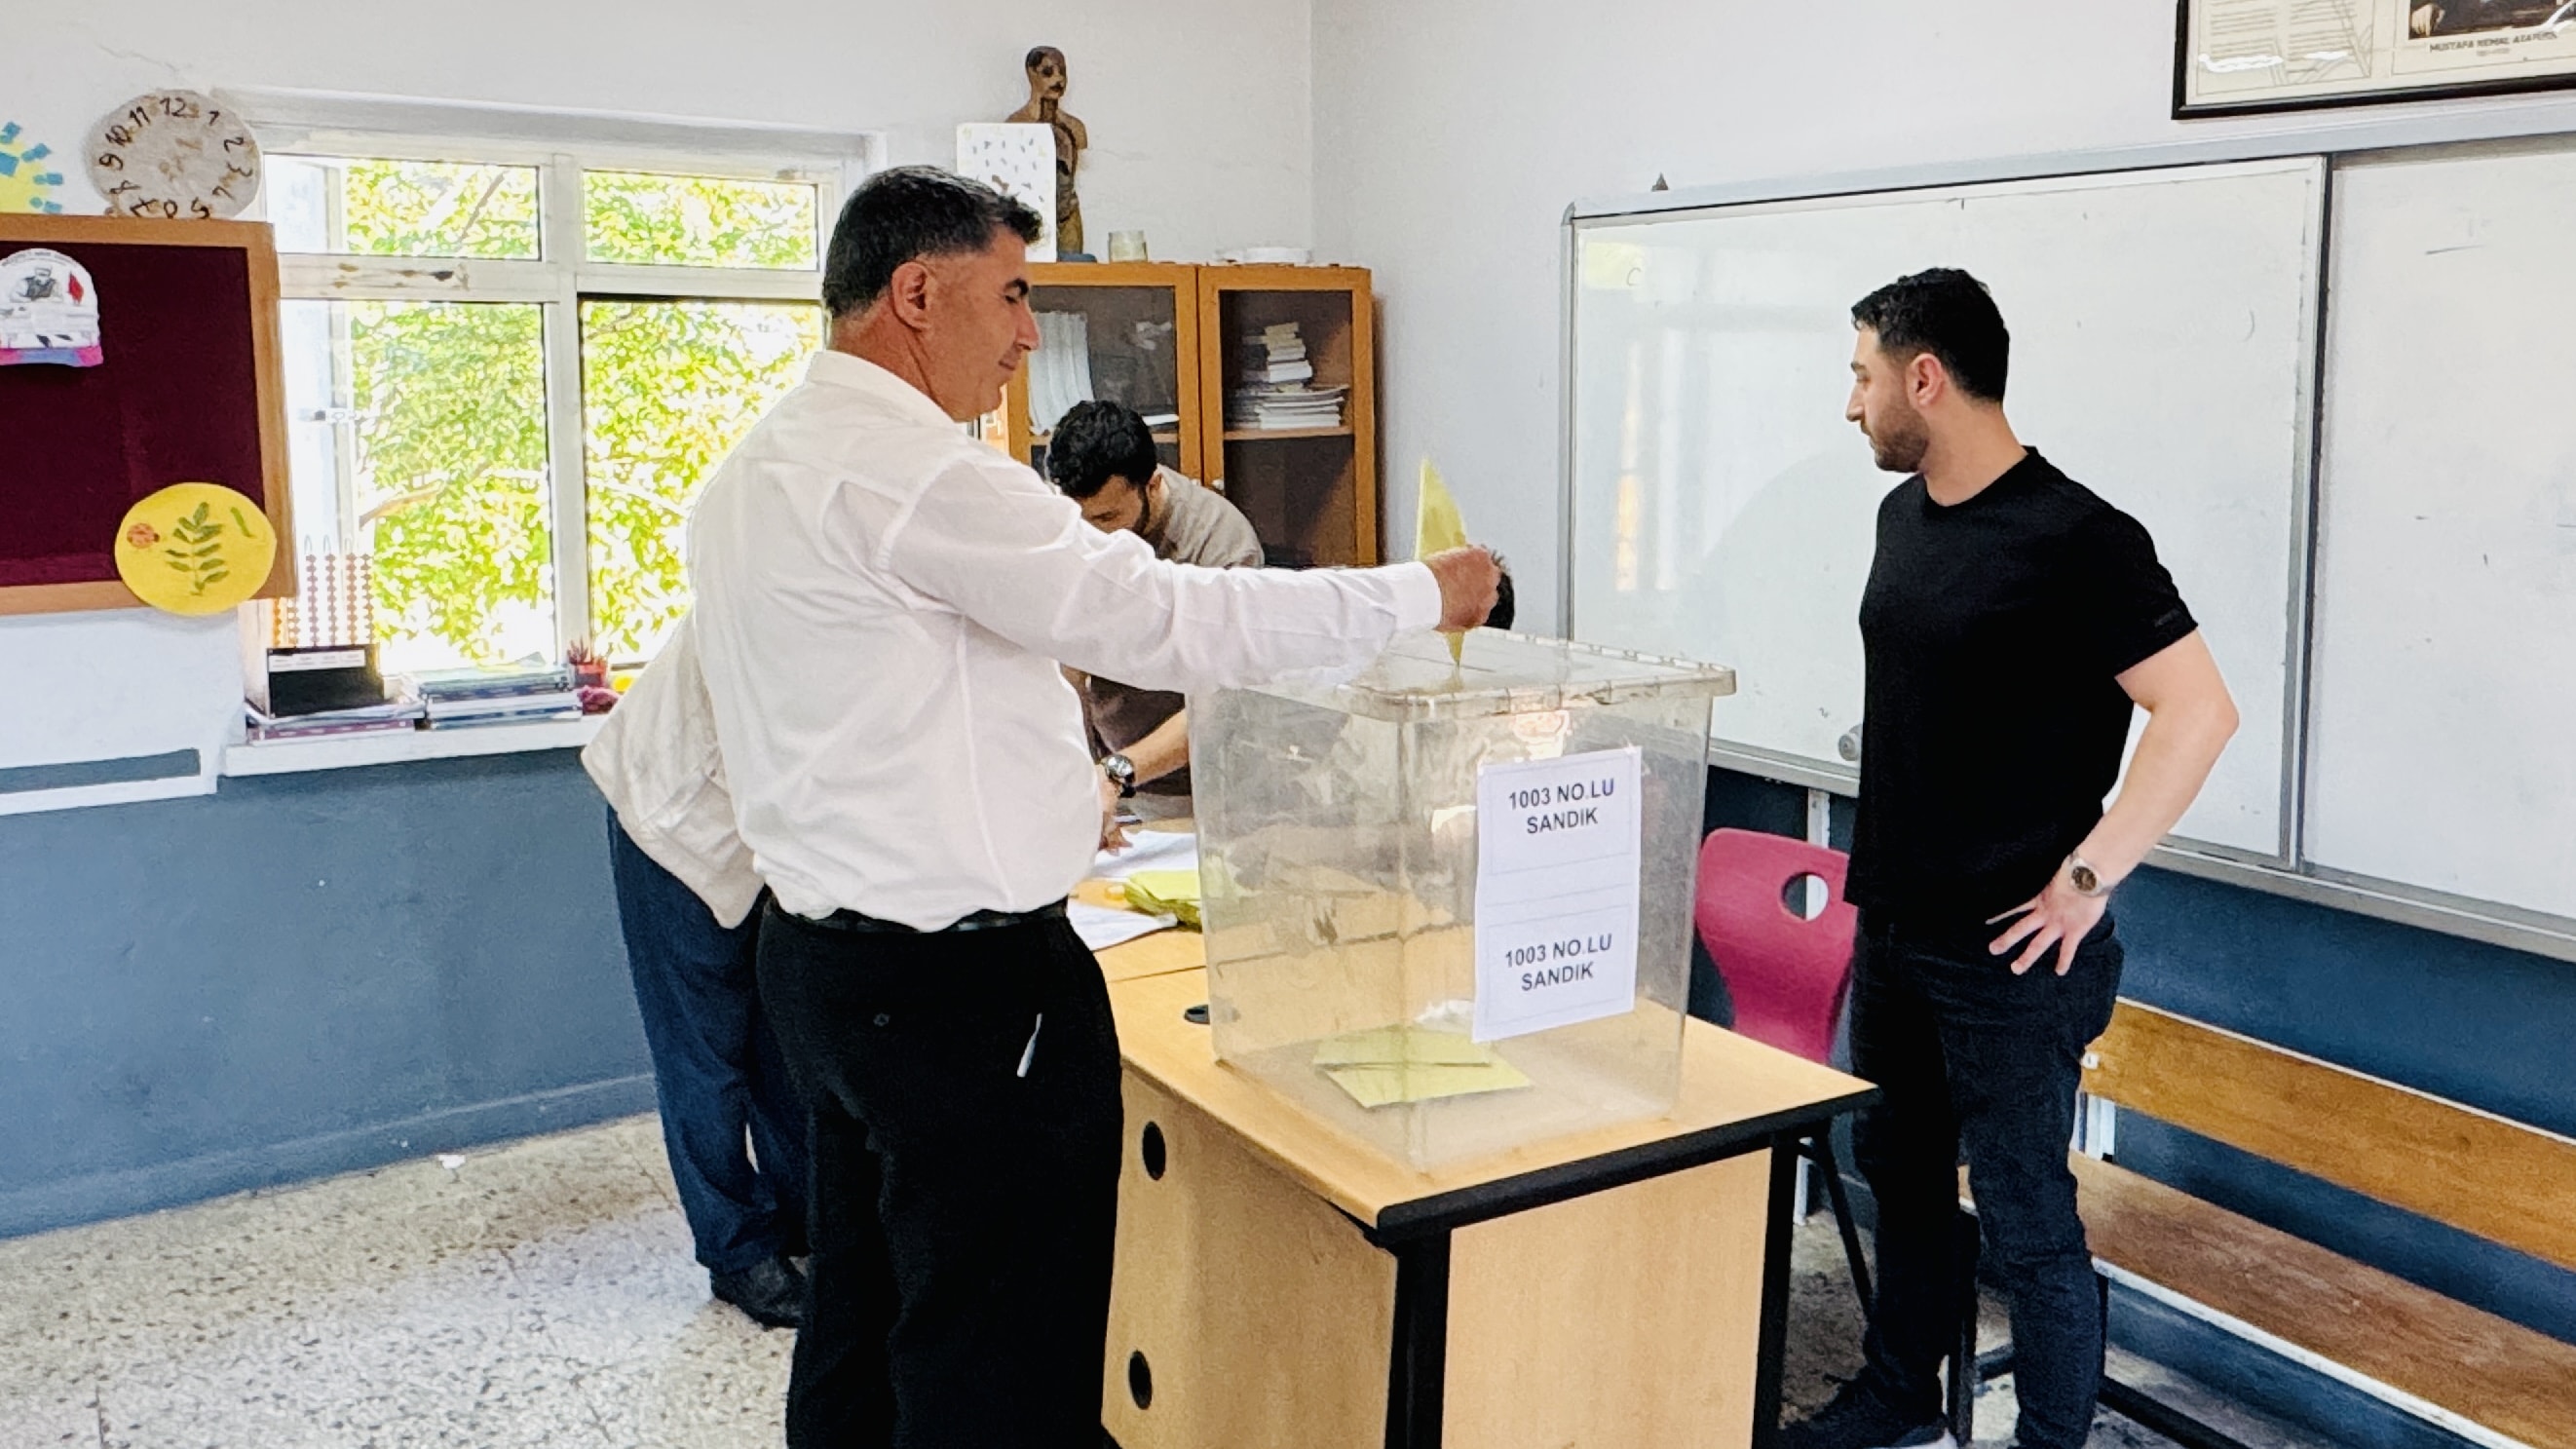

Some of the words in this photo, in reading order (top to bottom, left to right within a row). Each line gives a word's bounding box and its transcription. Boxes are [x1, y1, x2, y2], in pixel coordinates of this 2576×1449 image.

[129, 106, 151, 128] 11
[159, 97, 187, 117] 12
[208, 109, 220, 126] 1
[223, 136, 245, 153] 2
[98, 152, 124, 171] 9
[227, 162, 252, 176] 3
[190, 196, 210, 219] 5
[1508, 787, 1551, 810] 1003
[1557, 778, 1614, 802] NO.LU
[1527, 808, 1598, 834] SANDIK
[1505, 944, 1546, 968] 1003
[1553, 933, 1612, 960] NO.LU
[1521, 961, 1594, 991] SANDIK
